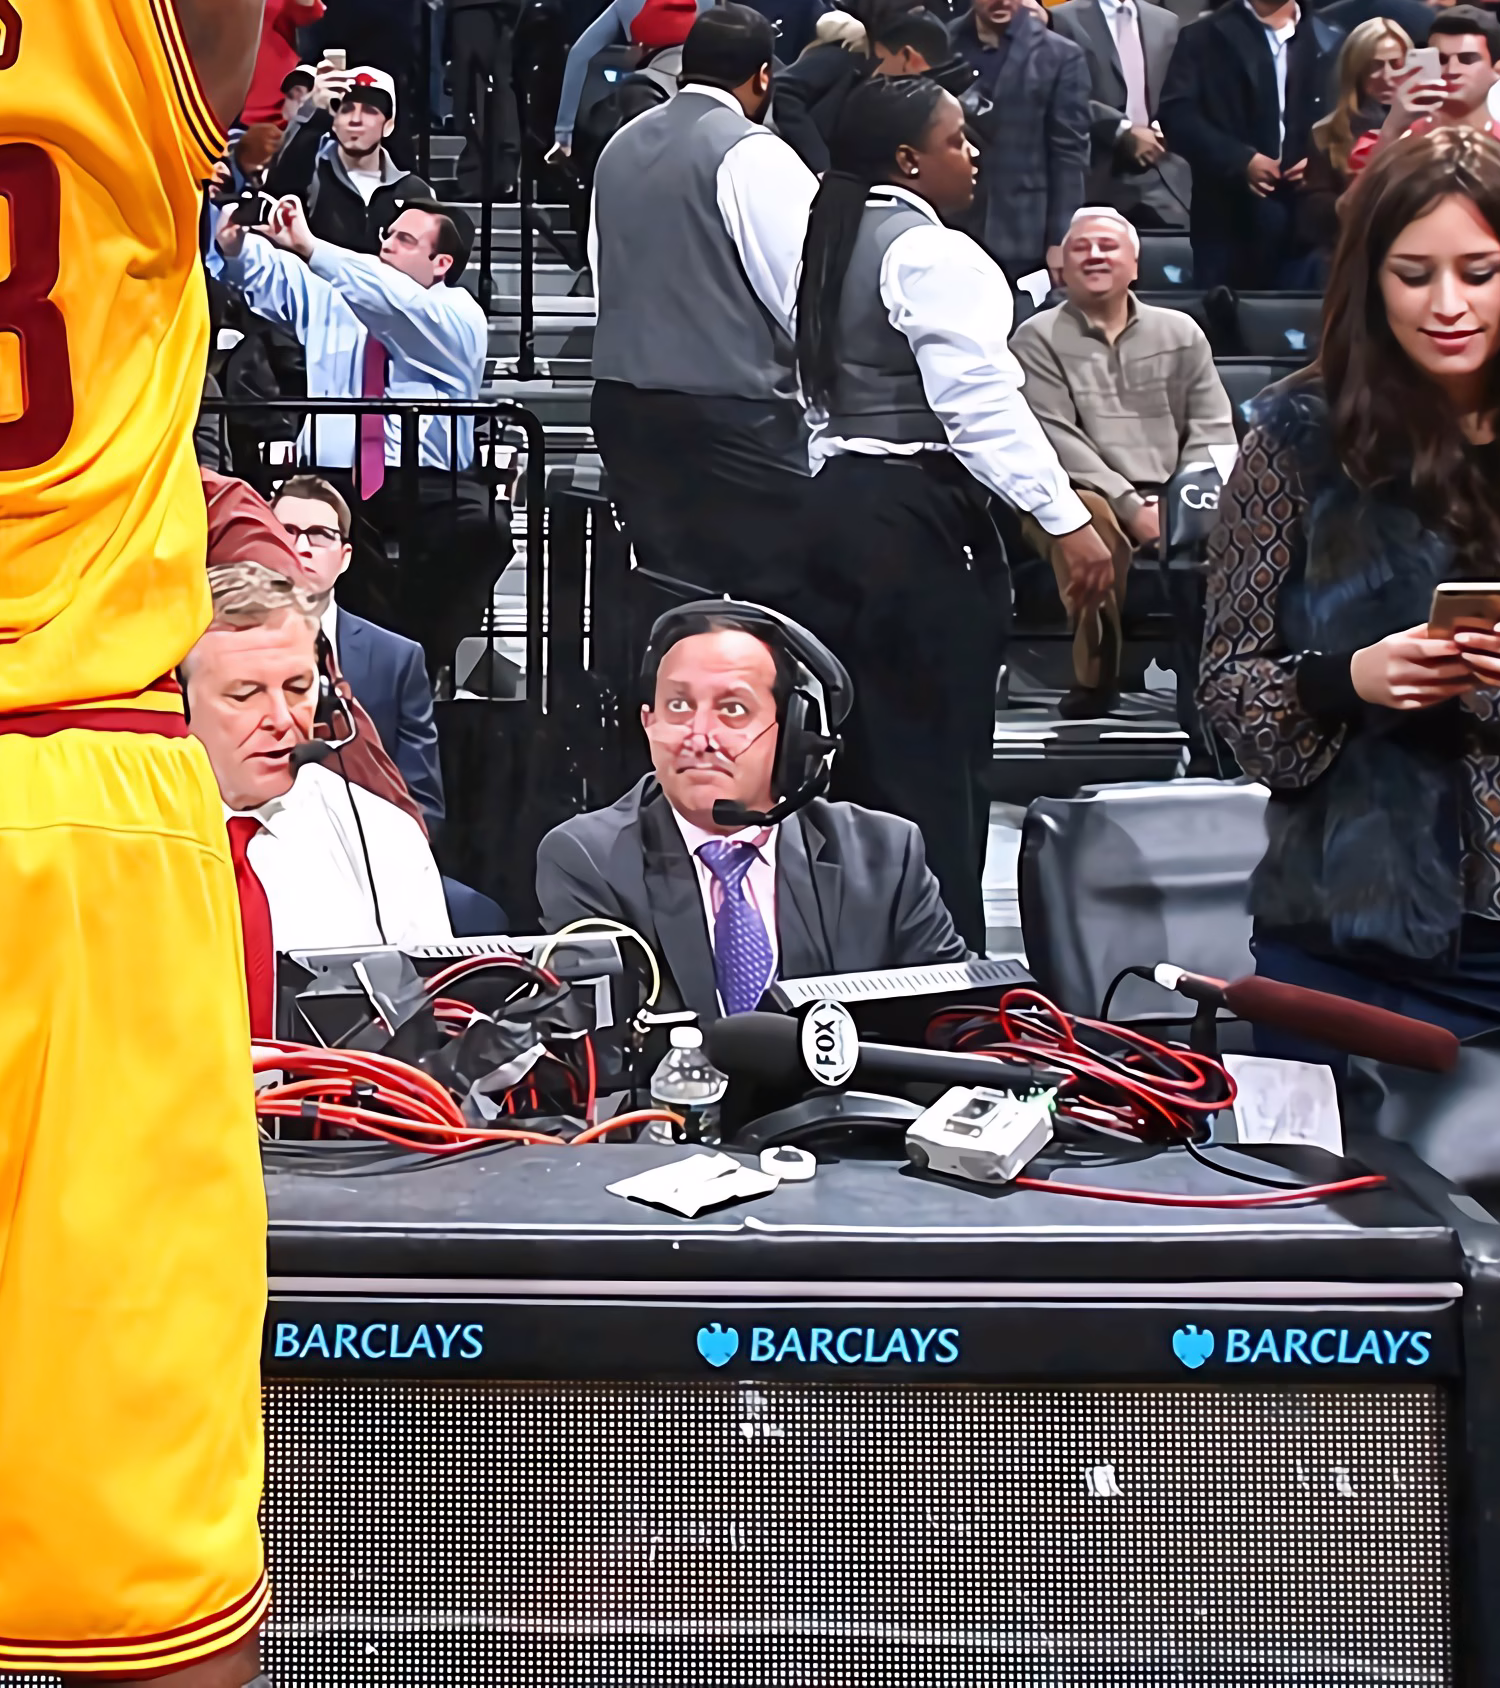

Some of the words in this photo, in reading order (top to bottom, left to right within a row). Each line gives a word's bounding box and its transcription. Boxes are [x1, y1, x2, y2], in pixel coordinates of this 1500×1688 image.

[814, 1020, 836, 1065] FOX
[274, 1323, 484, 1360] BARCLAYS
[750, 1326, 960, 1365] BARCLAYS
[1225, 1329, 1432, 1366] BARCLAYS
